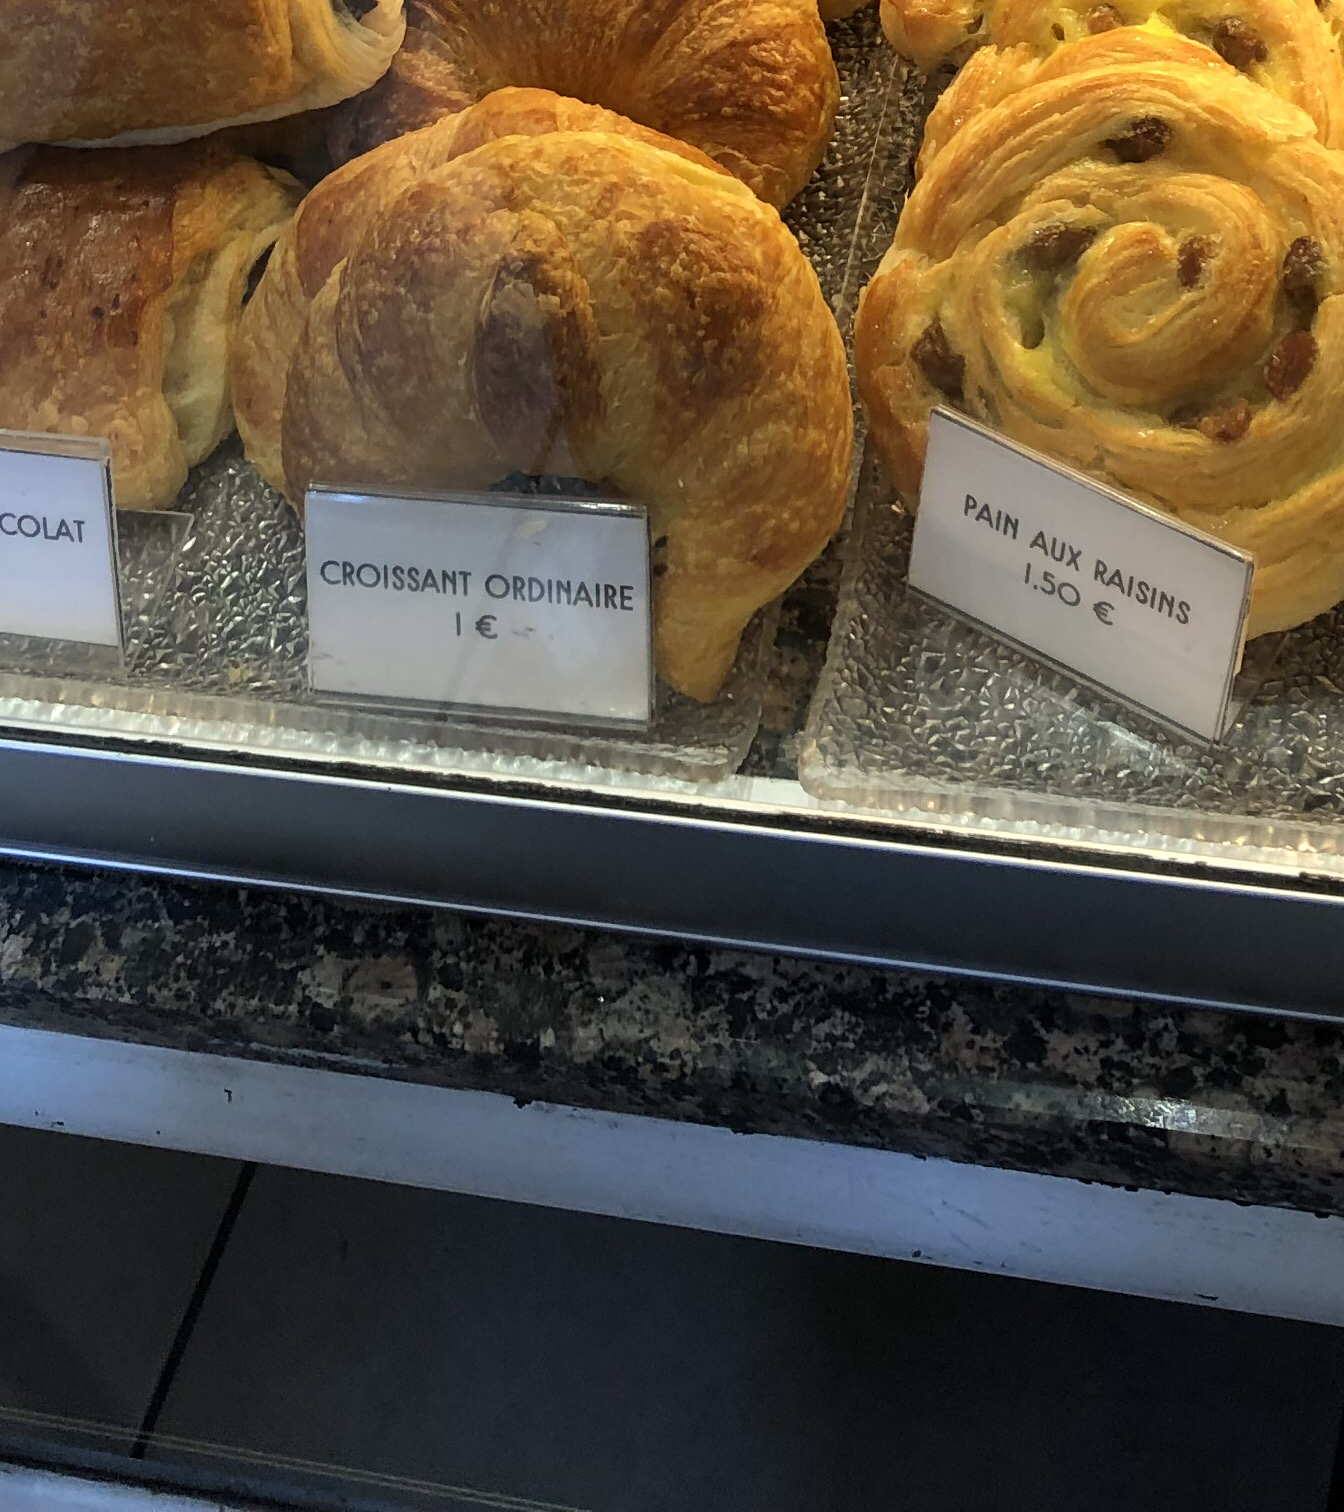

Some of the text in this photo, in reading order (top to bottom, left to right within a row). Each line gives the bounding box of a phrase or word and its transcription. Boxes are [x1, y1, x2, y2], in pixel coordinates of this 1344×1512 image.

[320, 560, 634, 611] CROISSANT ORDINAIRE
[963, 494, 1191, 625] PAIN AUX RAISINS
[1024, 563, 1115, 626] 1.50 €
[455, 612, 498, 640] 1 €
